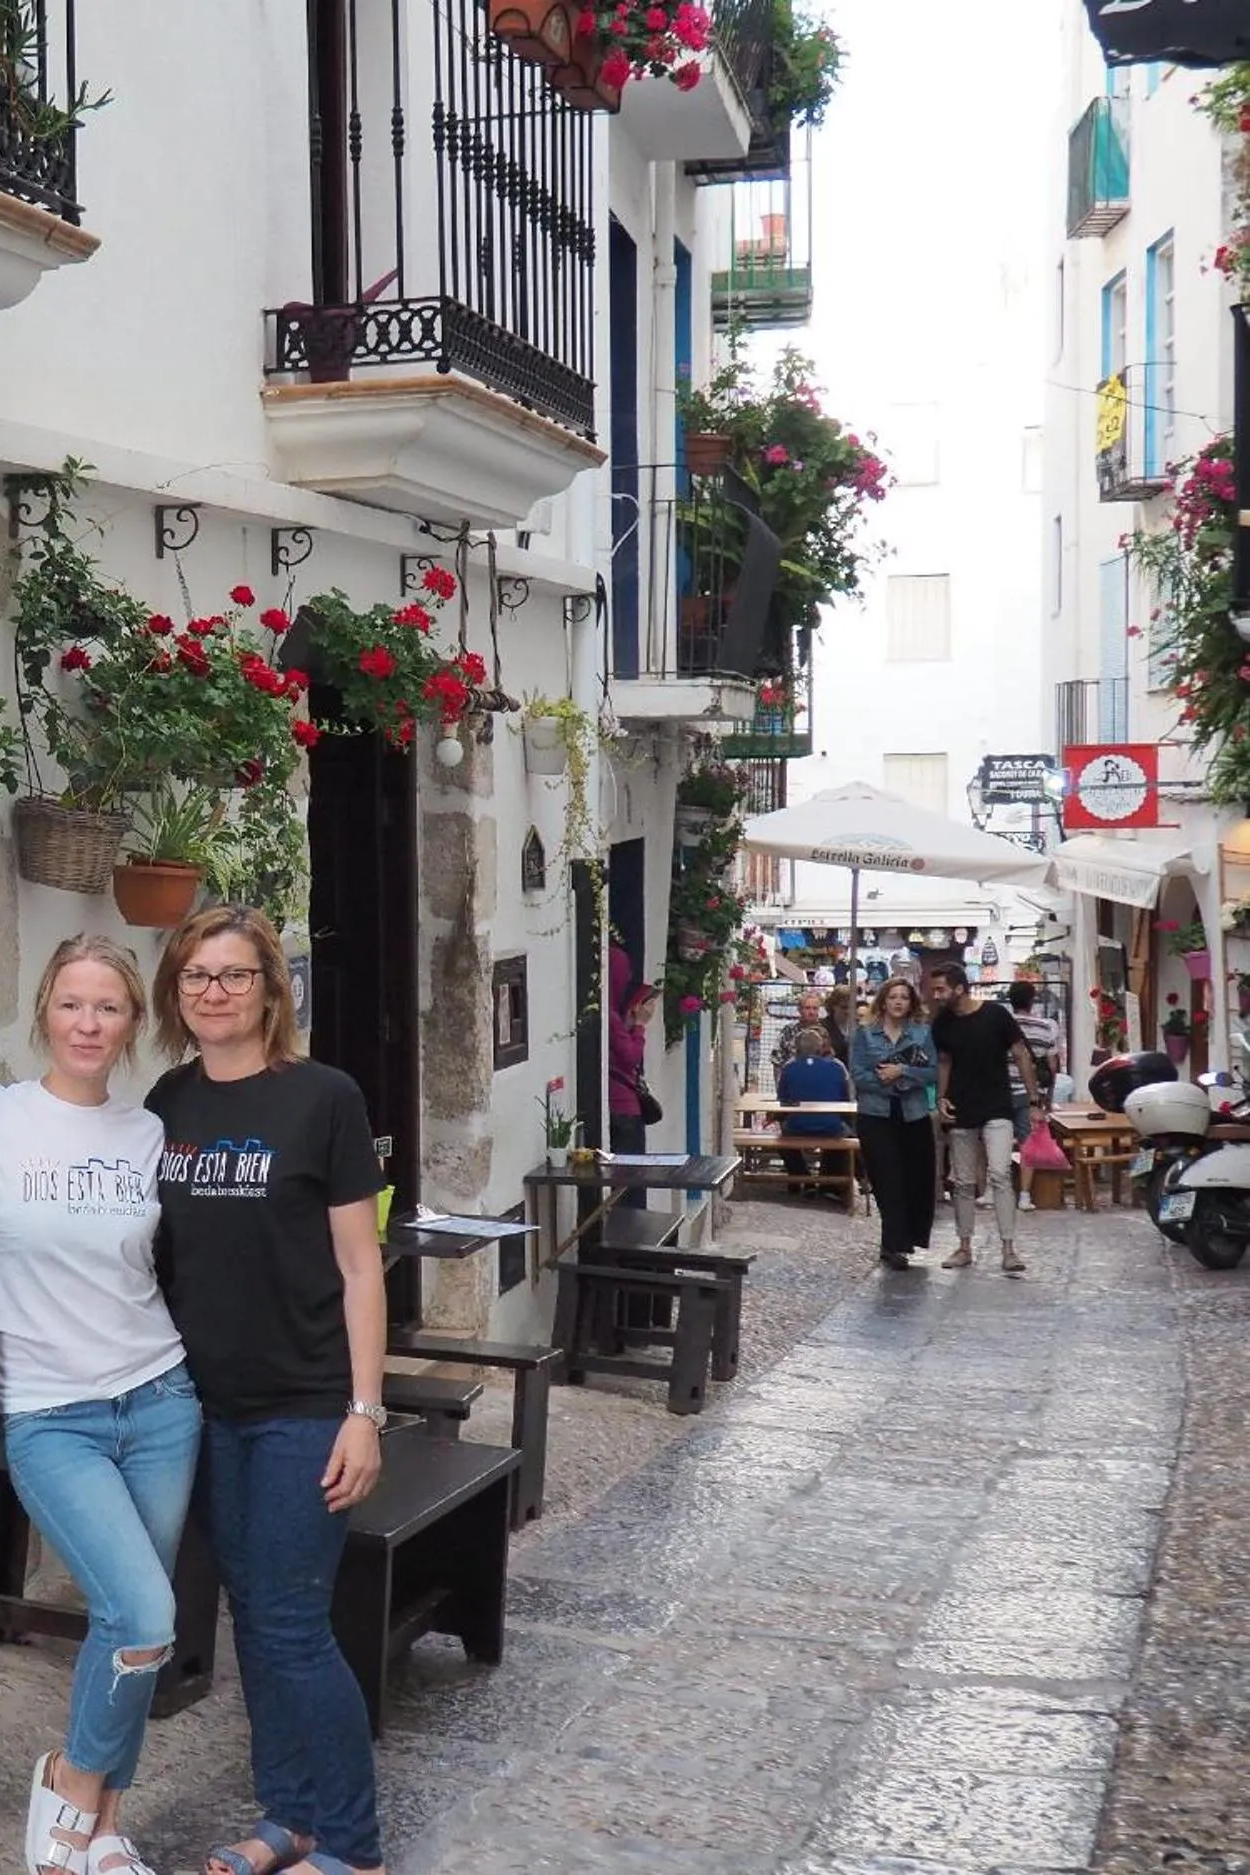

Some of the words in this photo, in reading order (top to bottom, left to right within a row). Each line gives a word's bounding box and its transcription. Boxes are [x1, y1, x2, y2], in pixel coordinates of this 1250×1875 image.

[991, 760, 1046, 770] TASCA
[862, 852, 909, 868] Galicia
[194, 1151, 227, 1183] ESTA
[234, 1152, 272, 1183] BIEN
[23, 1170, 58, 1202] DIOS
[67, 1169, 106, 1201] ESTA
[114, 1172, 145, 1204] BIEN
